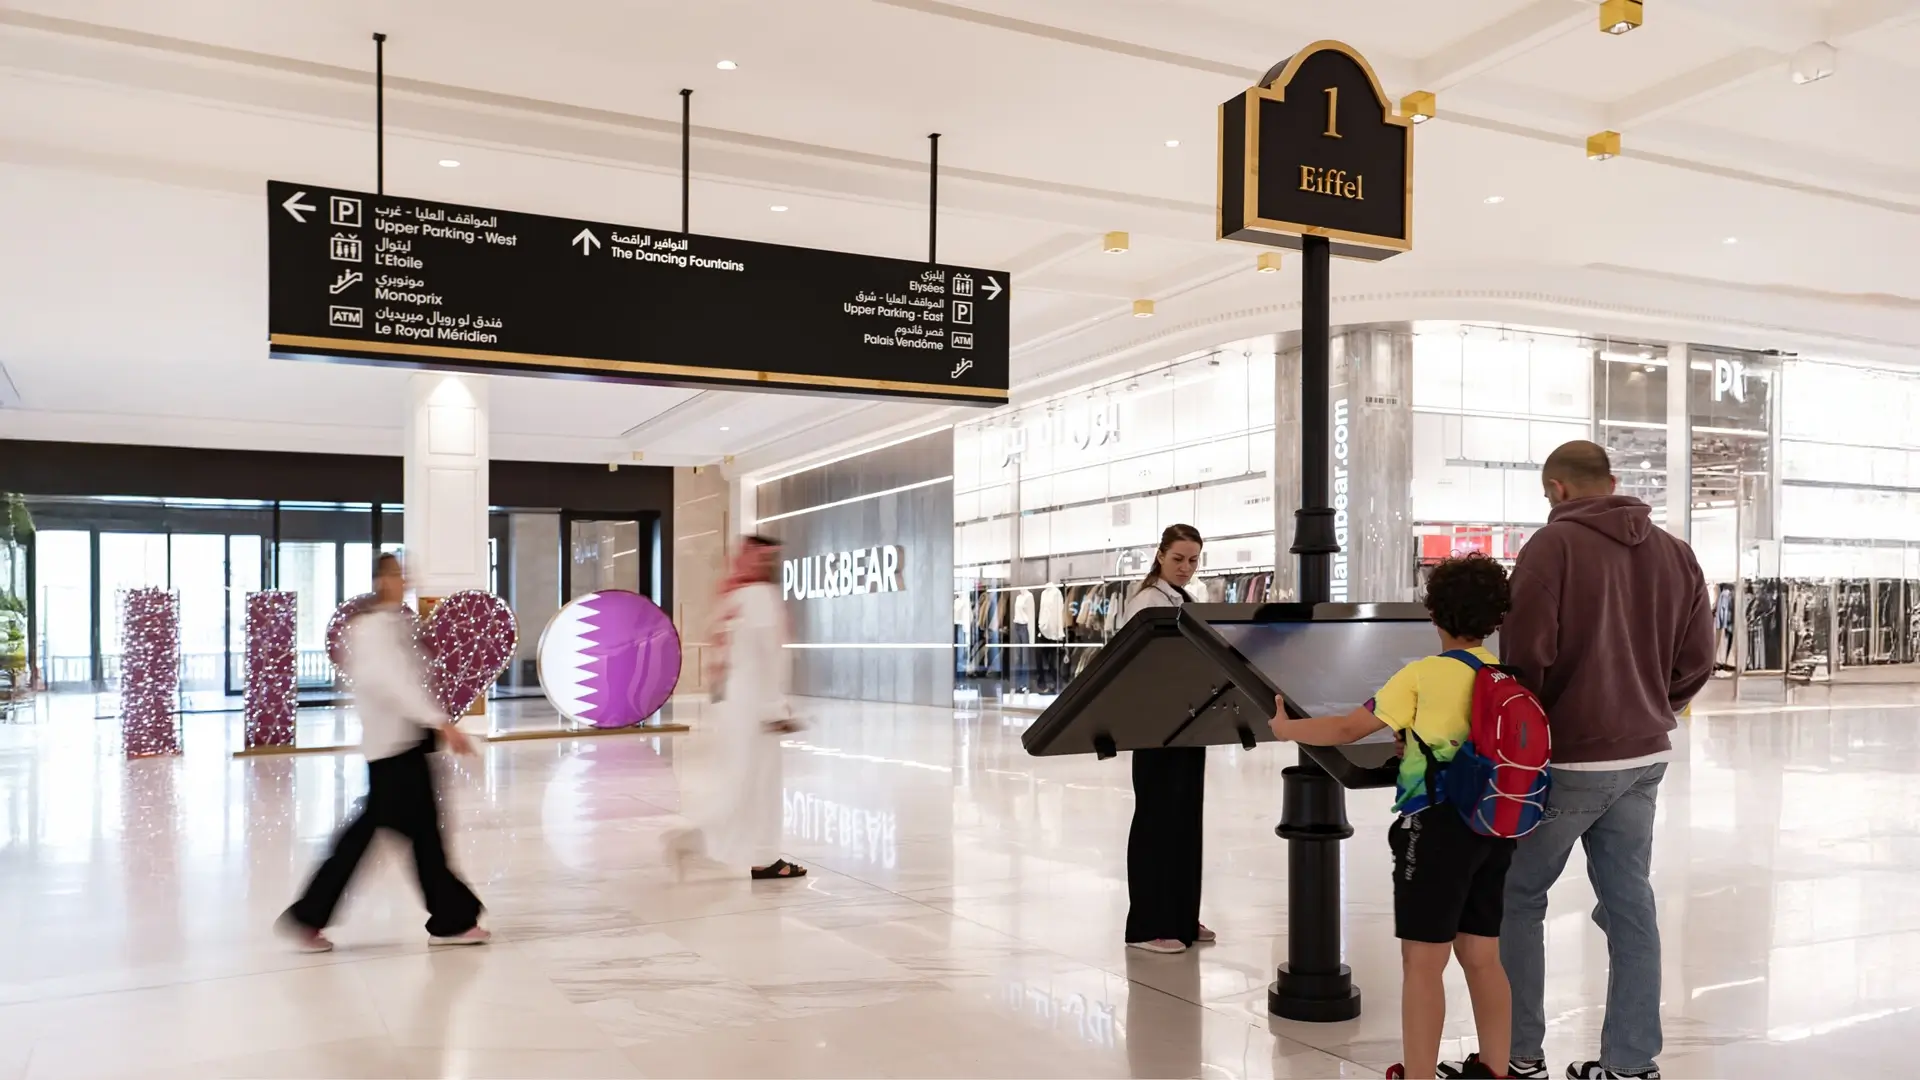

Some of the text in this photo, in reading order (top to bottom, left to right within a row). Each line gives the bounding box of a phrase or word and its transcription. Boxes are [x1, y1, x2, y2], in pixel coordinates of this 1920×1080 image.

[1322, 86, 1343, 138] 1
[1298, 164, 1364, 200] Eiffel
[375, 205, 402, 218] غرب
[415, 206, 445, 222] العليا
[447, 213, 498, 228] المواقف
[374, 218, 420, 235] Upper
[422, 224, 474, 243] Parking
[485, 231, 517, 246] West
[375, 237, 411, 254] ليتوال
[611, 231, 688, 251] النوافير الراقصة
[374, 253, 423, 269] L'Etoile
[611, 246, 744, 272] The Dancing Fountains
[375, 274, 424, 289] مونوبري
[909, 280, 945, 294] Elysées
[374, 288, 443, 306] Monoprix
[855, 290, 877, 302] شرق
[886, 292, 907, 306] العليا
[908, 297, 945, 310] المواقف
[333, 311, 360, 323] ATM
[375, 307, 503, 329] فندق لو رويال ميريديان
[843, 302, 876, 316] Upper
[877, 306, 915, 322] Parking
[923, 311, 944, 322] East
[374, 322, 498, 343] Le Royal Méridien
[924, 327, 944, 338] قصر
[954, 336, 971, 345] ATM
[864, 333, 944, 350] Palais Vendôme
[783, 544, 899, 601] PULL&BEAR
